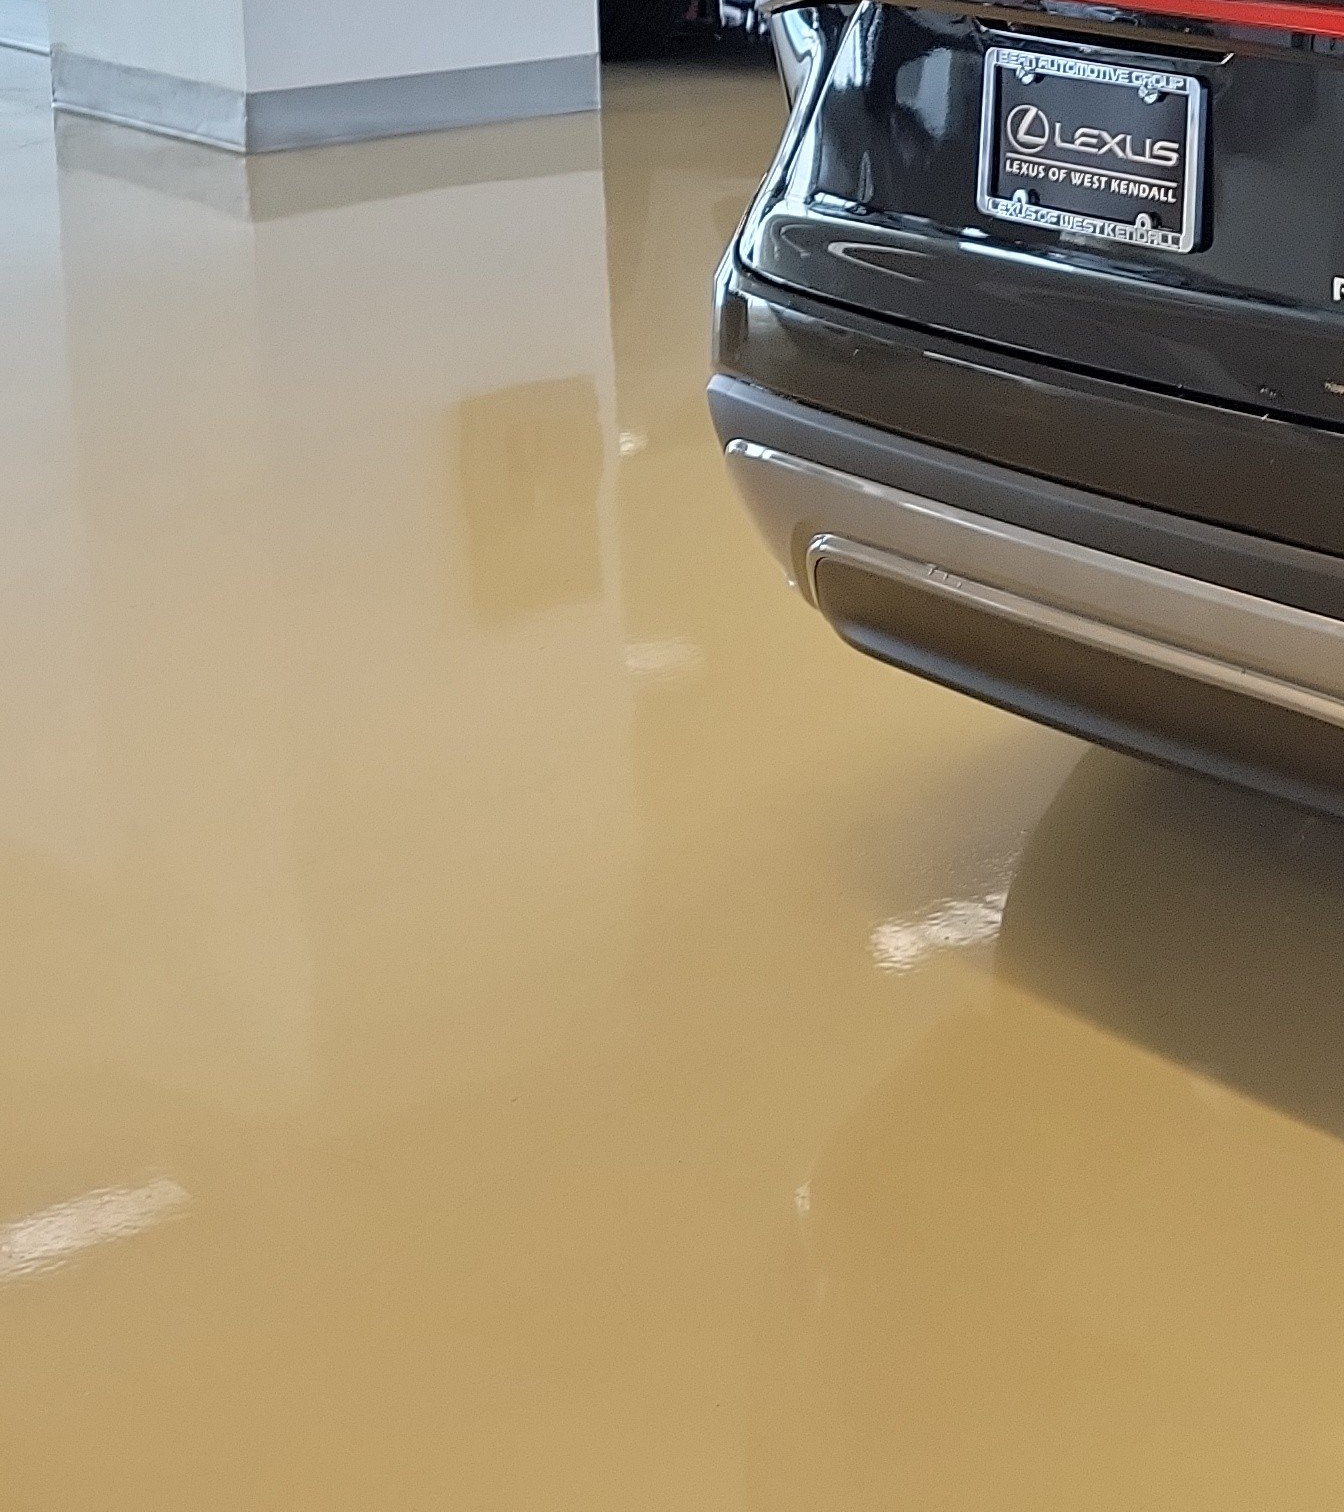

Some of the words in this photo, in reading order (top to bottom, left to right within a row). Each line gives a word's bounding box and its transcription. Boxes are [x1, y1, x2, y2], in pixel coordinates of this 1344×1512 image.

[1038, 58, 1130, 83] AUTOMOTIVE
[1131, 71, 1184, 90] GROUP
[1055, 122, 1180, 167] LEXUS
[1005, 159, 1045, 179] LEXUS
[1048, 167, 1068, 184] OF
[1070, 170, 1108, 191] WEST
[1110, 178, 1177, 204] KENDALL
[987, 199, 1036, 222] LEXUS
[1037, 209, 1058, 224] OF
[1059, 214, 1104, 235] WEST
